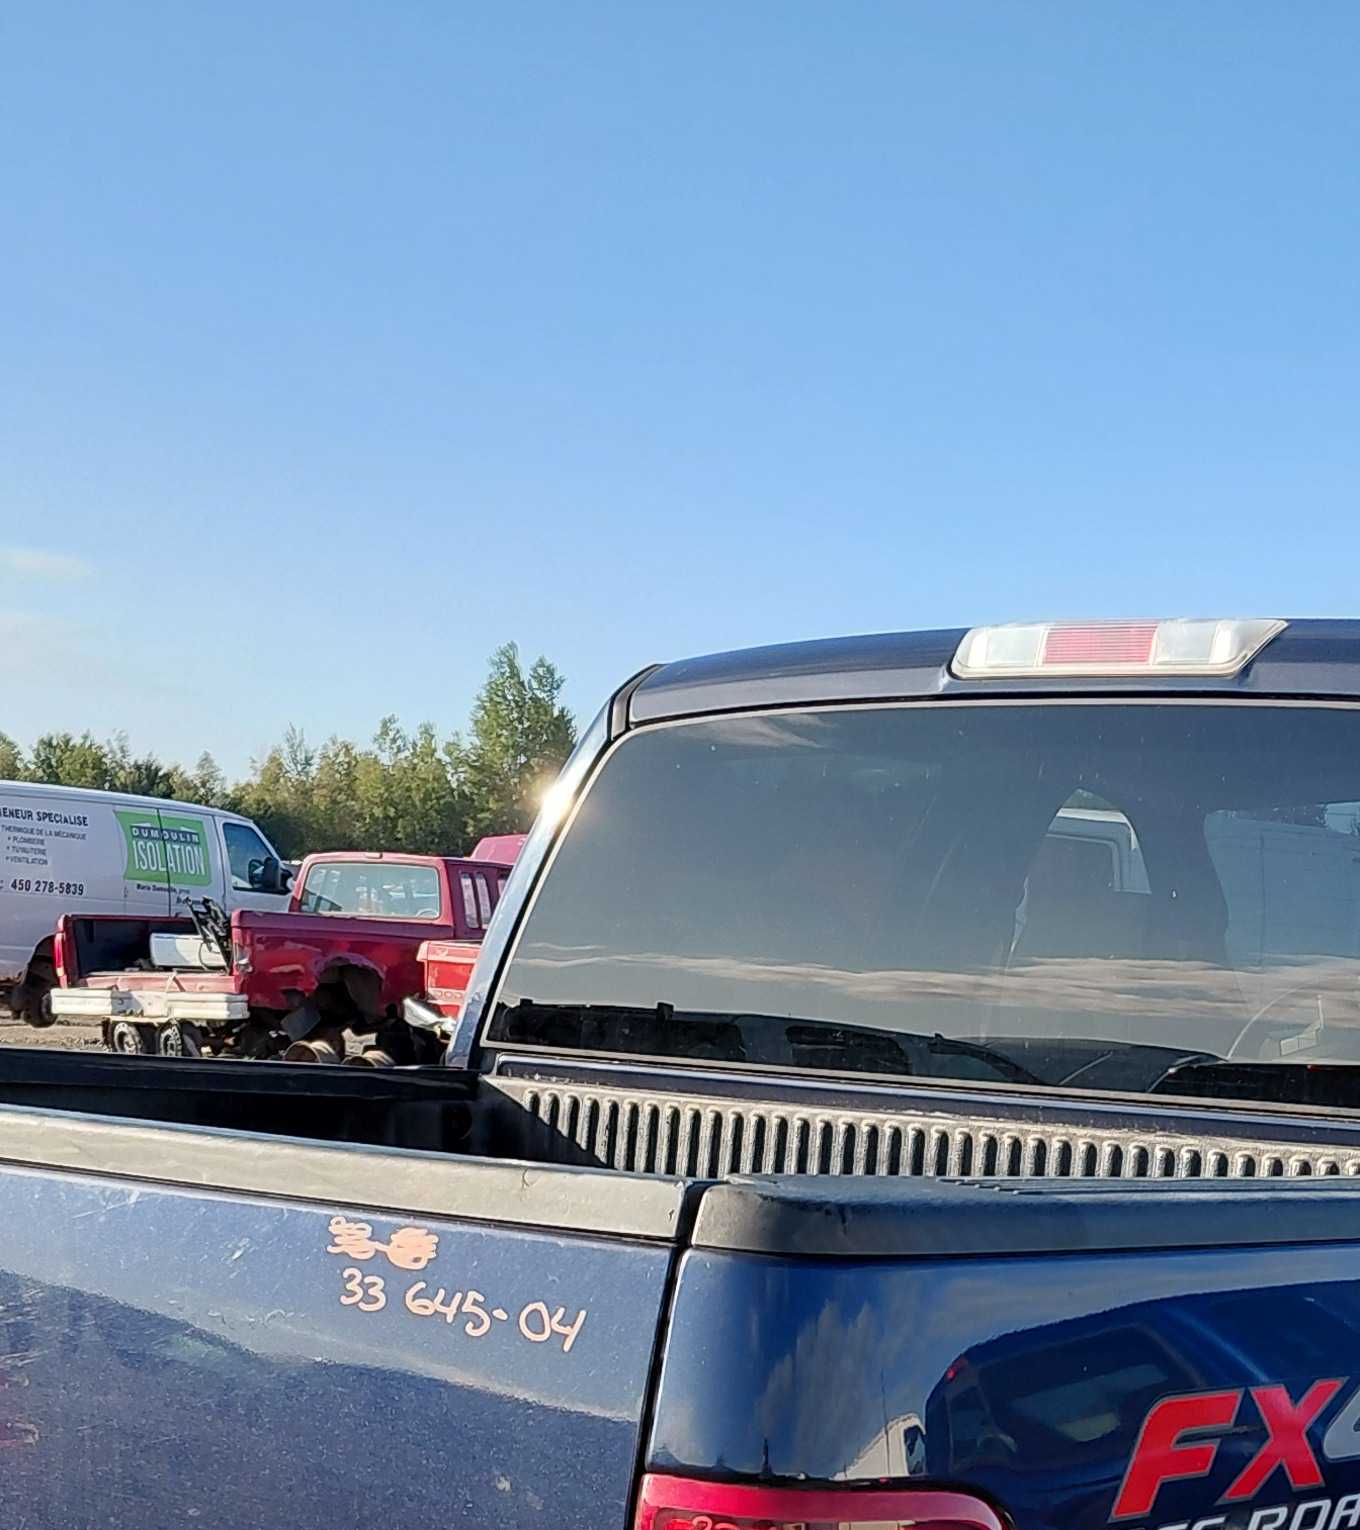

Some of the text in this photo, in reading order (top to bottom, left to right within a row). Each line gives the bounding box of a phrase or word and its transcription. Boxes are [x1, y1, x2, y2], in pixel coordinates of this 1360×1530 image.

[132, 840, 205, 876] ISOLATION
[11, 878, 31, 892] 450
[35, 880, 84, 896] 278-5839
